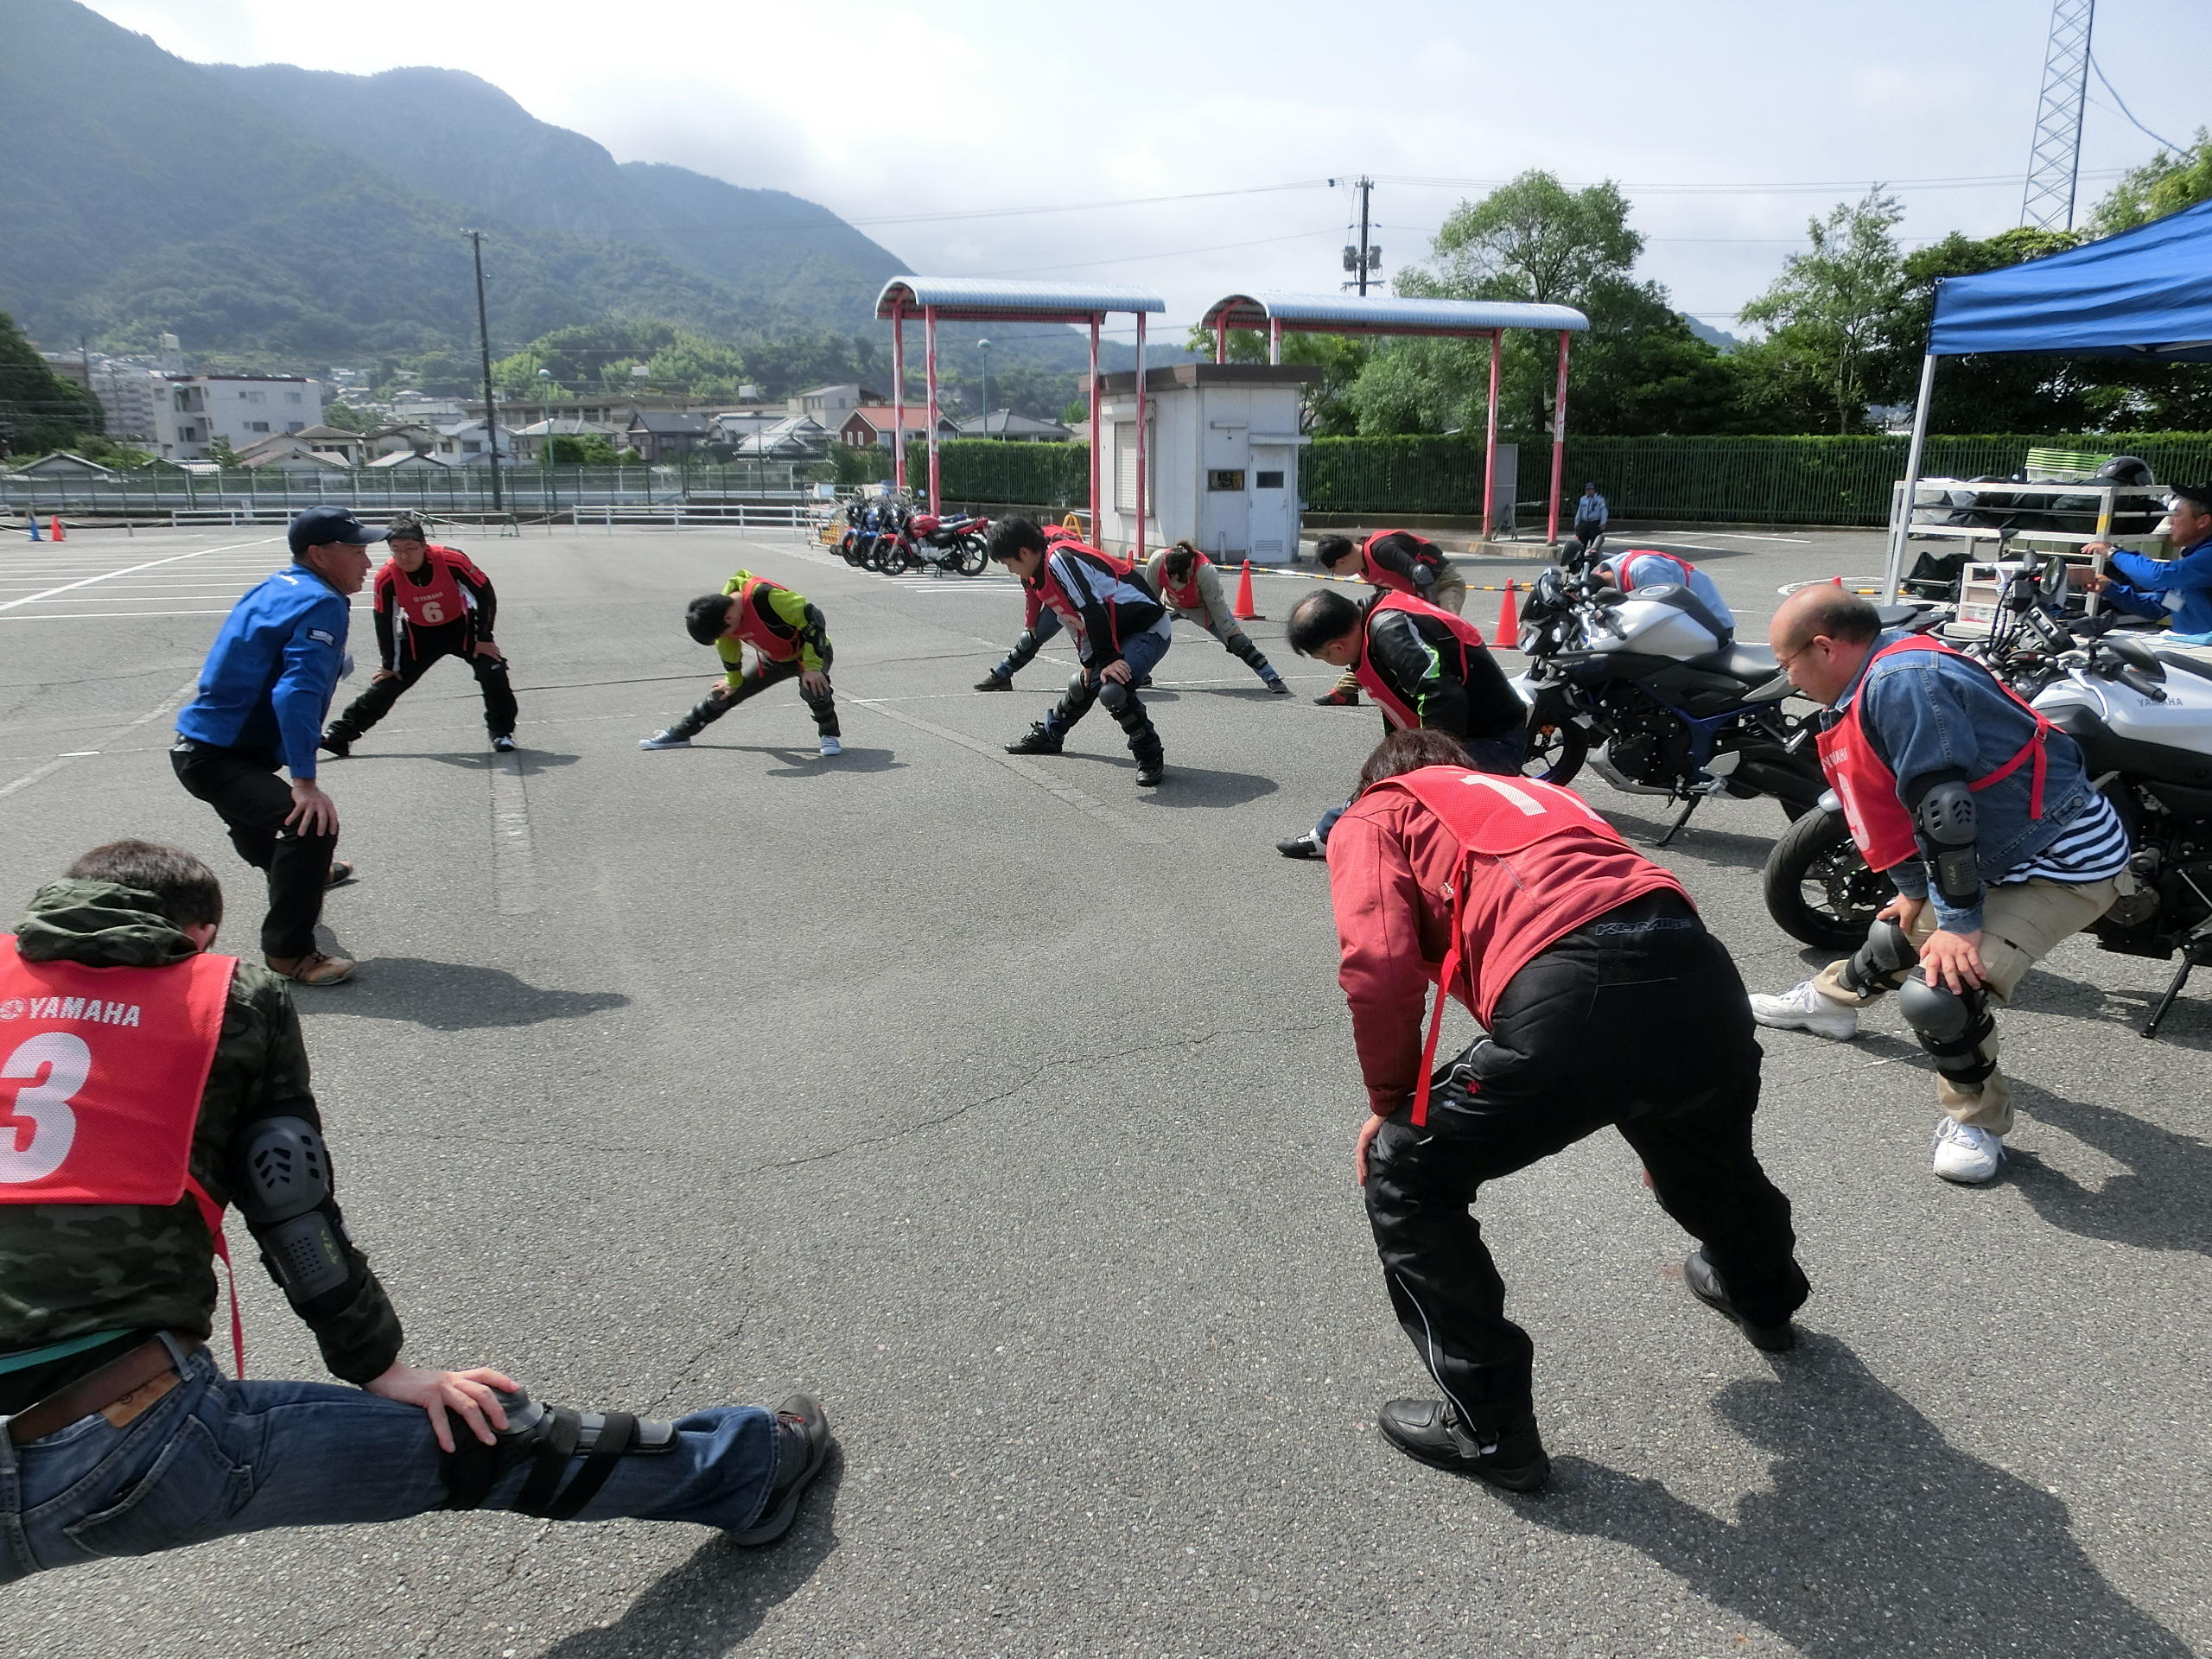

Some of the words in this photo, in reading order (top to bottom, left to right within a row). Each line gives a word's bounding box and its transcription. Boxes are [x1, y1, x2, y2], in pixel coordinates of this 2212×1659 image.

[422, 601, 444, 623] 6
[29, 996, 141, 1027] YAMAHA
[0, 1031, 92, 1184] 3
